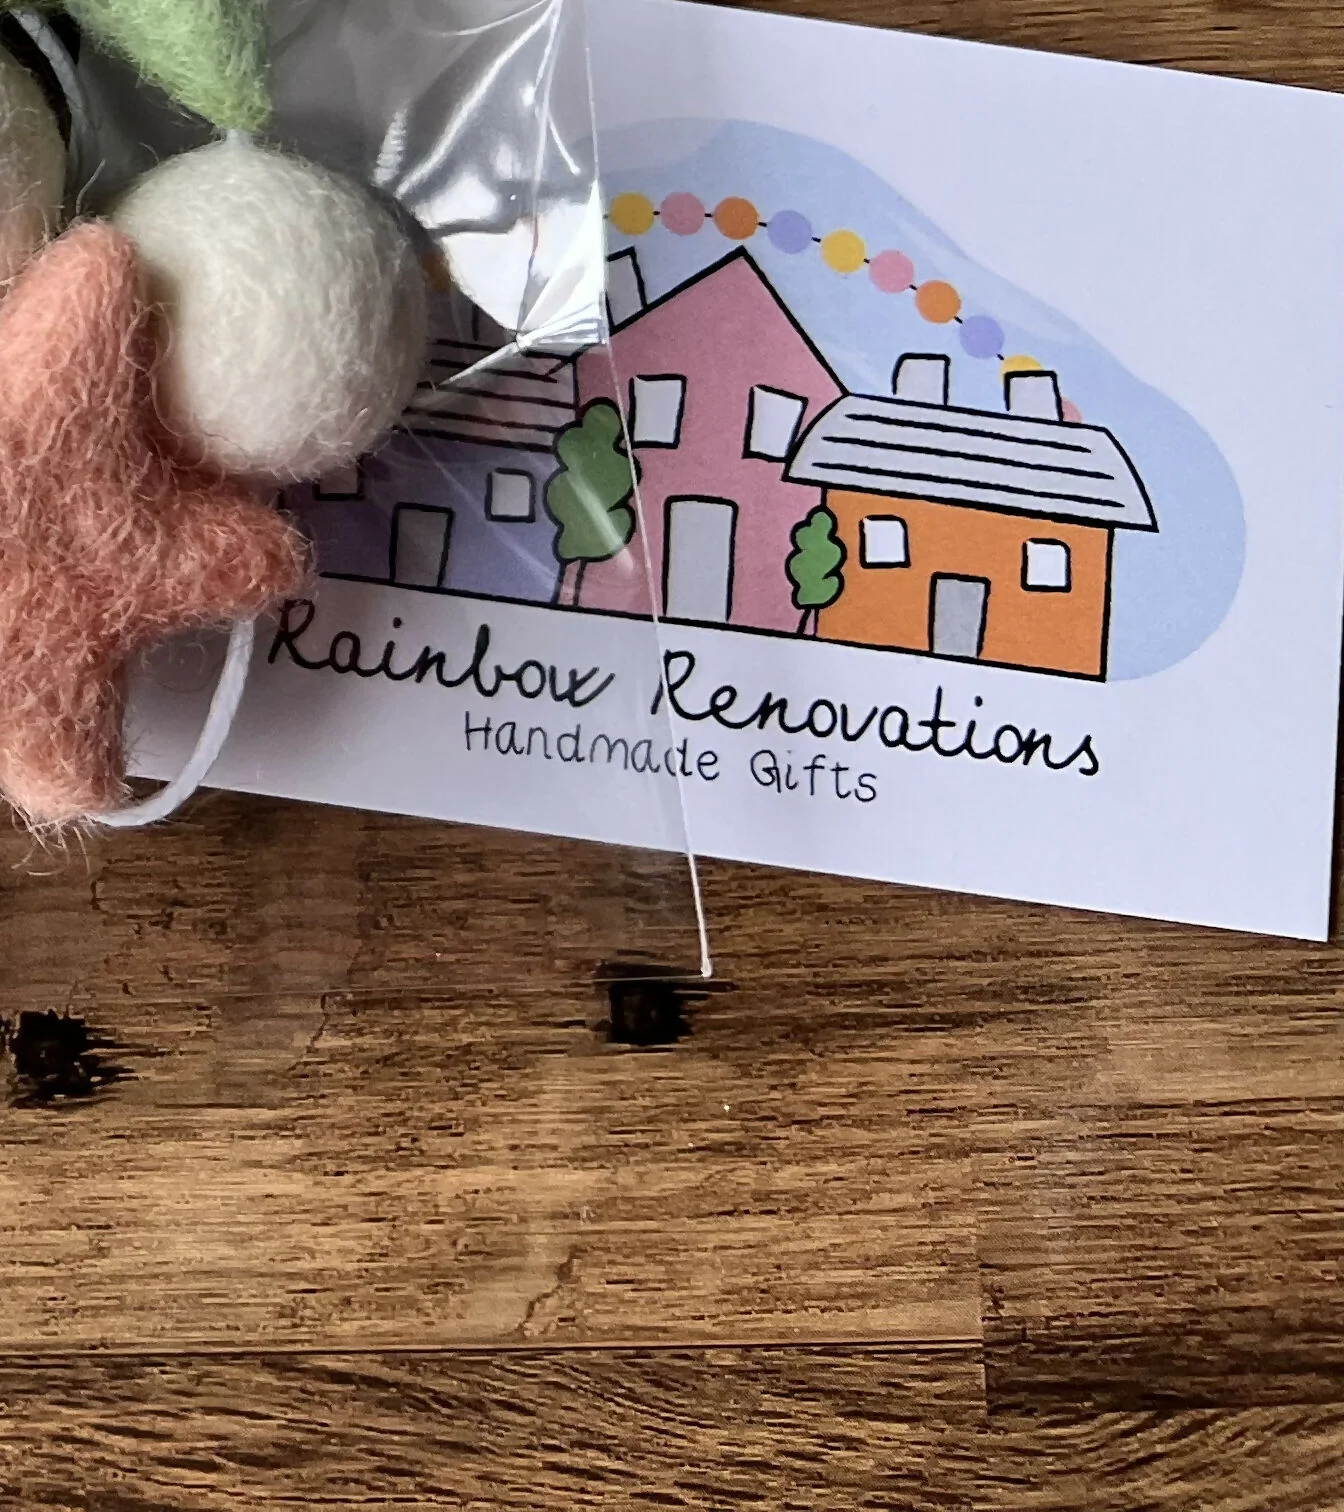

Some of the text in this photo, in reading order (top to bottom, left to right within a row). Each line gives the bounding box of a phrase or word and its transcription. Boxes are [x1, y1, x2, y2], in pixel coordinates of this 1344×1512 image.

[267, 598, 1101, 777] Rainbow Renovations
[464, 710, 879, 803] Handmade Gifts
